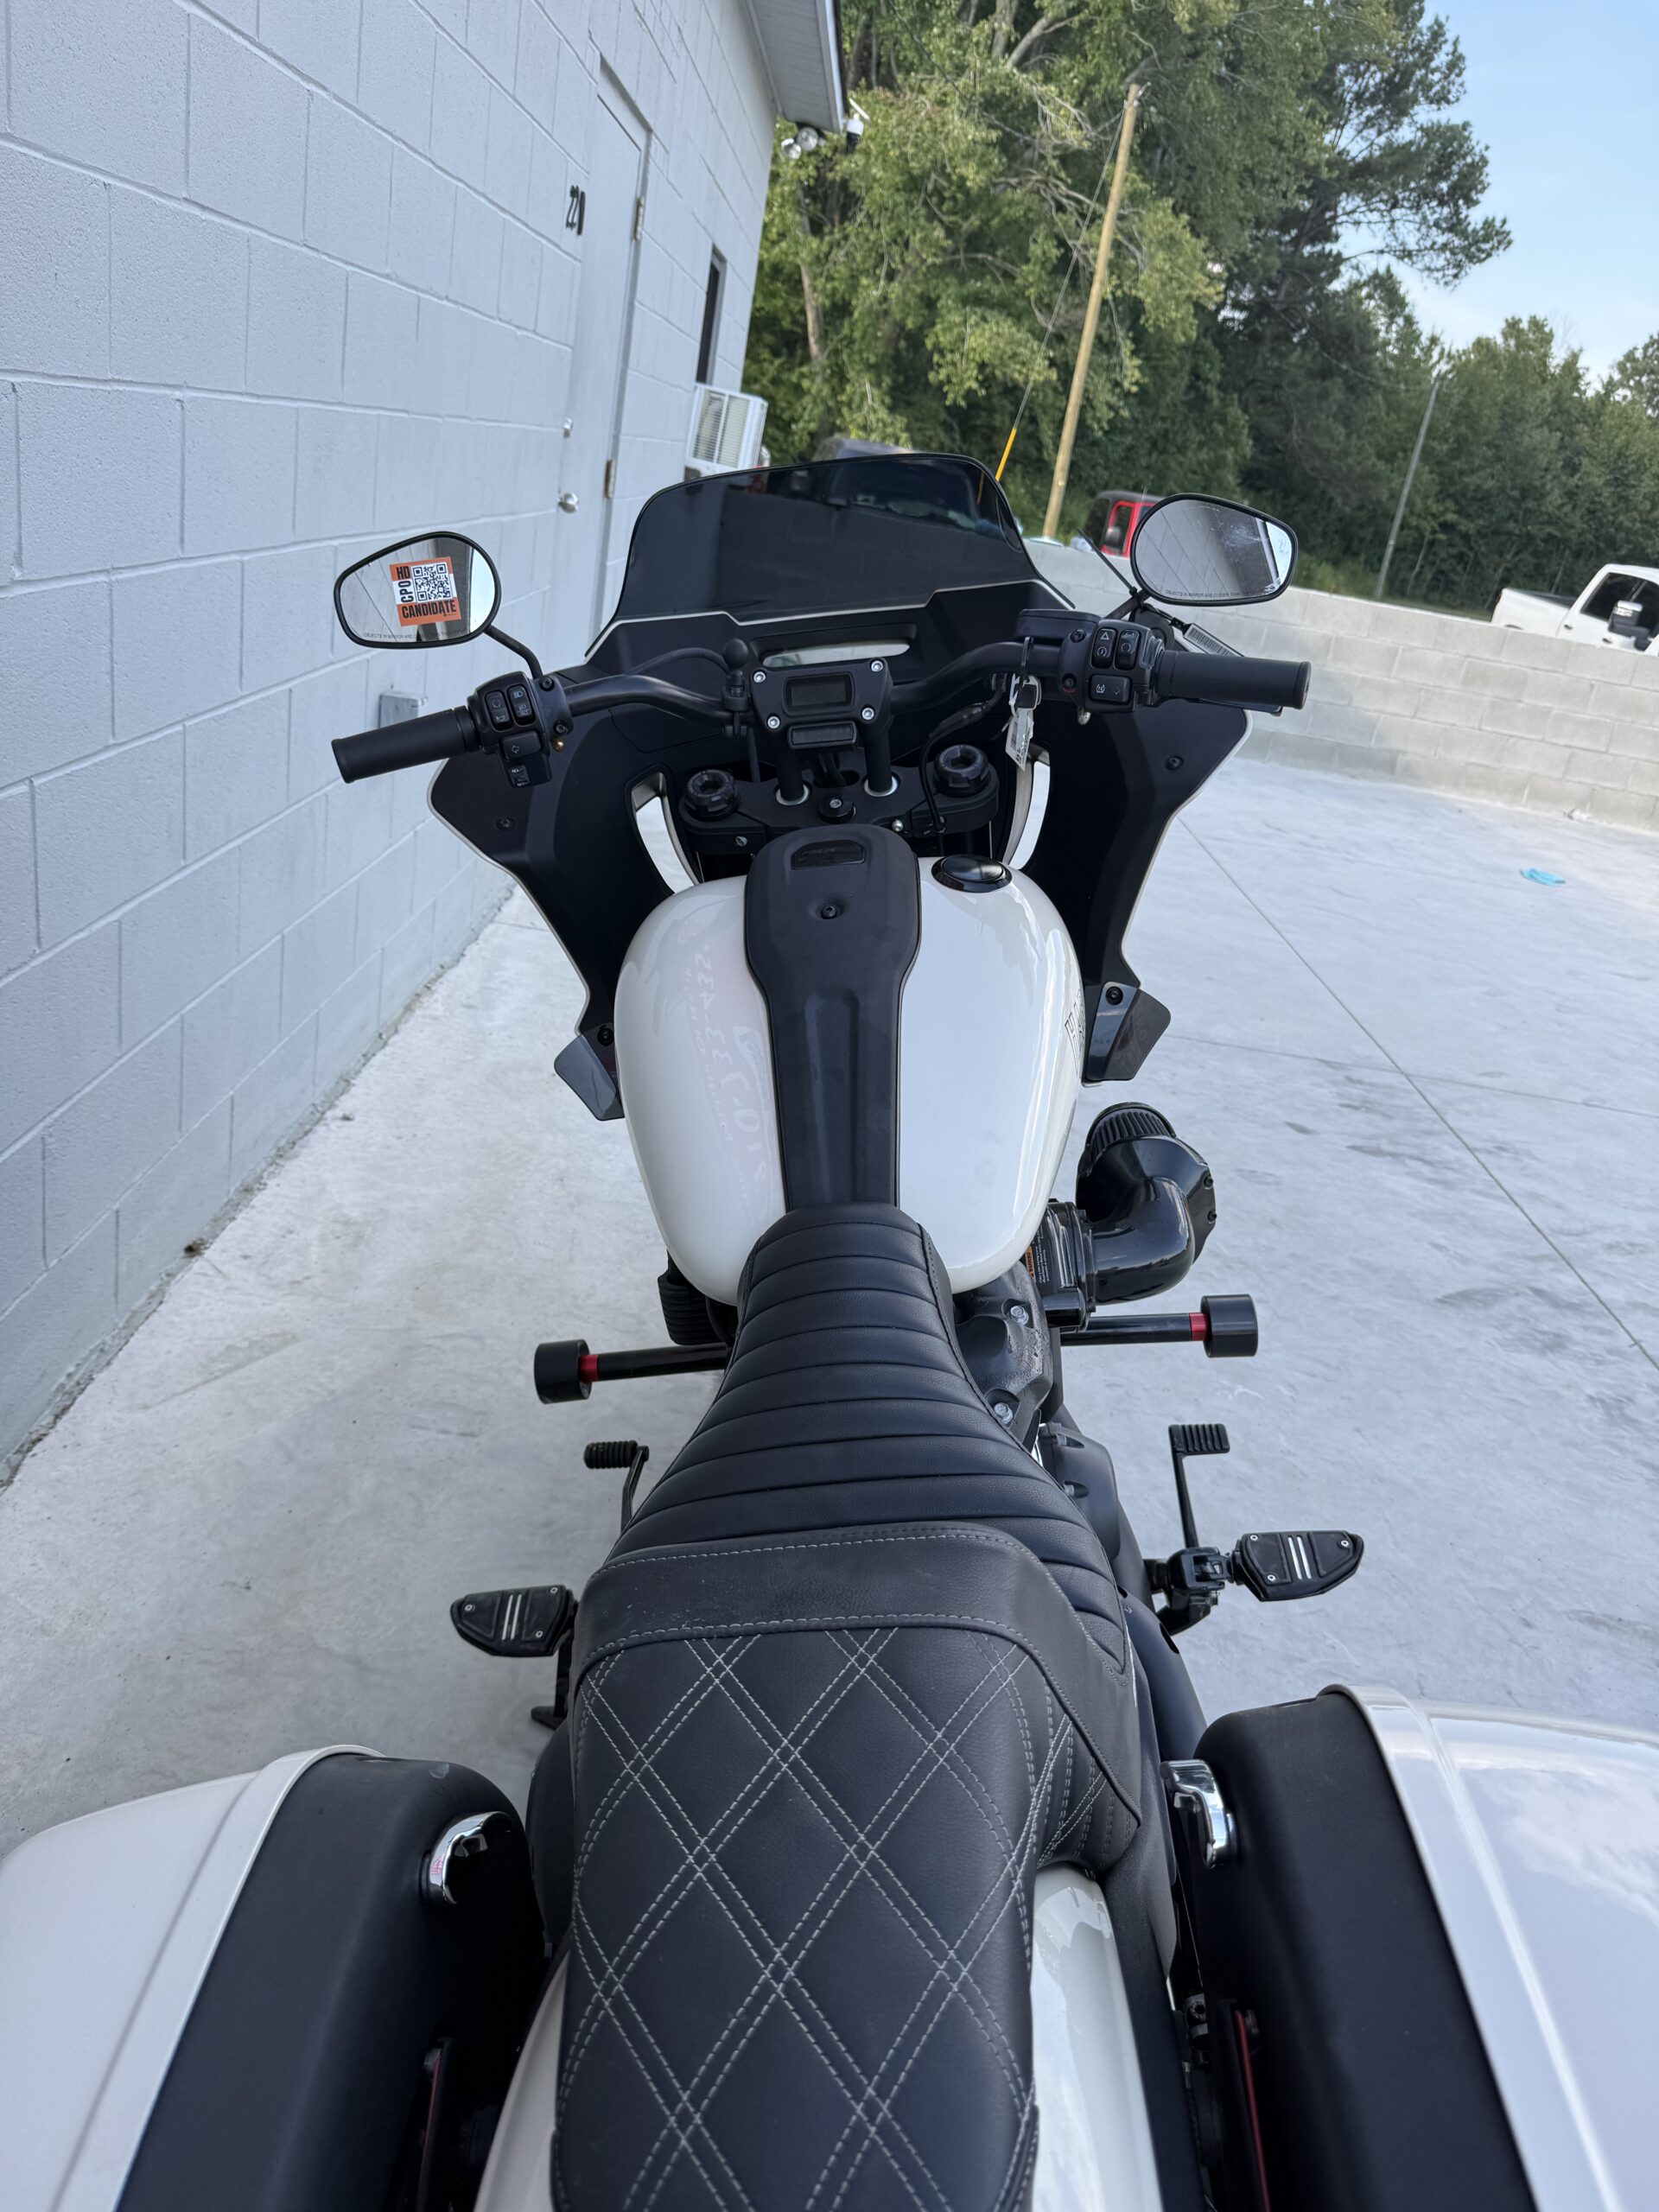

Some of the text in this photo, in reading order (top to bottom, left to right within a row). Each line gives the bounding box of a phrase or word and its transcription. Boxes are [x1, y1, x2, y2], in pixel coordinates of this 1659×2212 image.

[397, 566, 410, 580] HD
[398, 580, 414, 603] CPO
[402, 600, 457, 619] CANDIDATE
